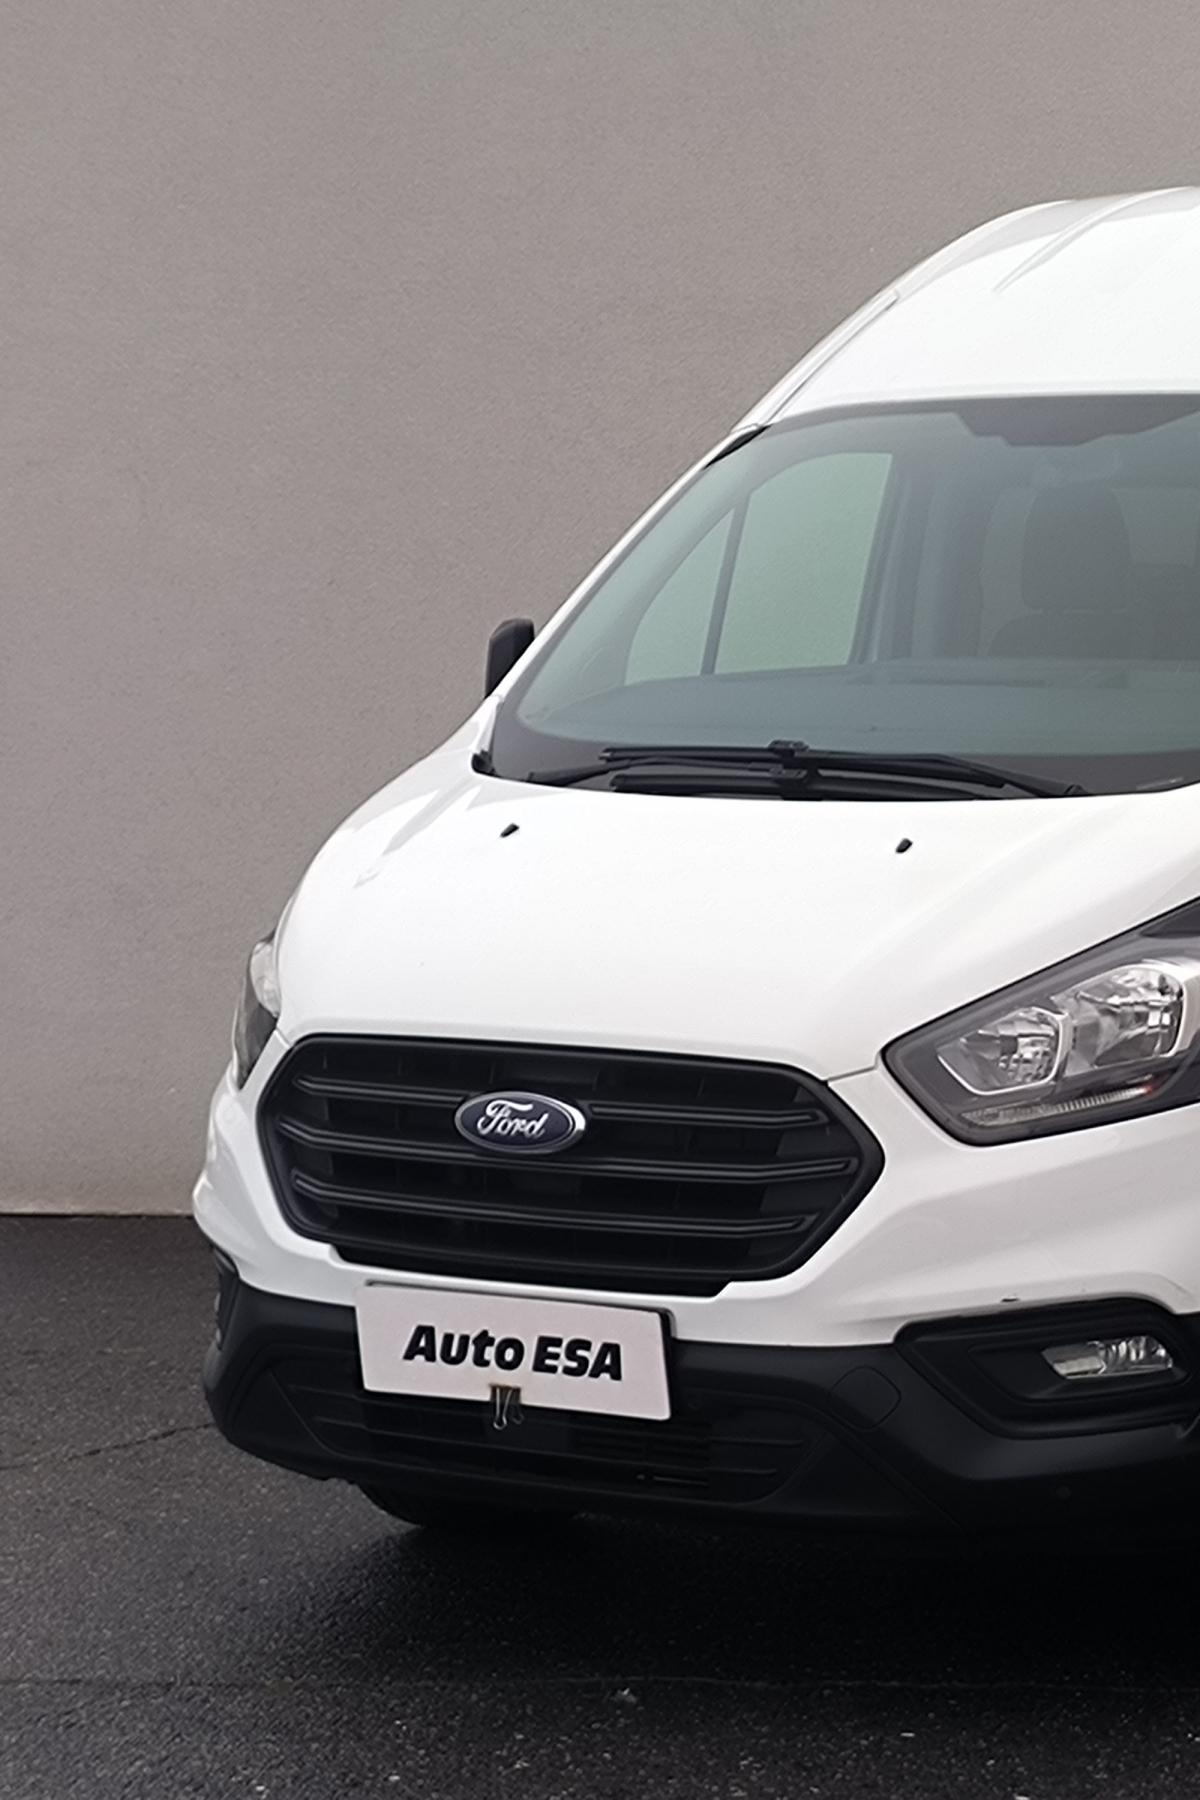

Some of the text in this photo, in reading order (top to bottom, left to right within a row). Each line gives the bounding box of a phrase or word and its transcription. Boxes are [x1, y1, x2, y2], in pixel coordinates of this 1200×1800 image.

[477, 1099, 549, 1138] Ford
[403, 1324, 622, 1381] Auto ESA
